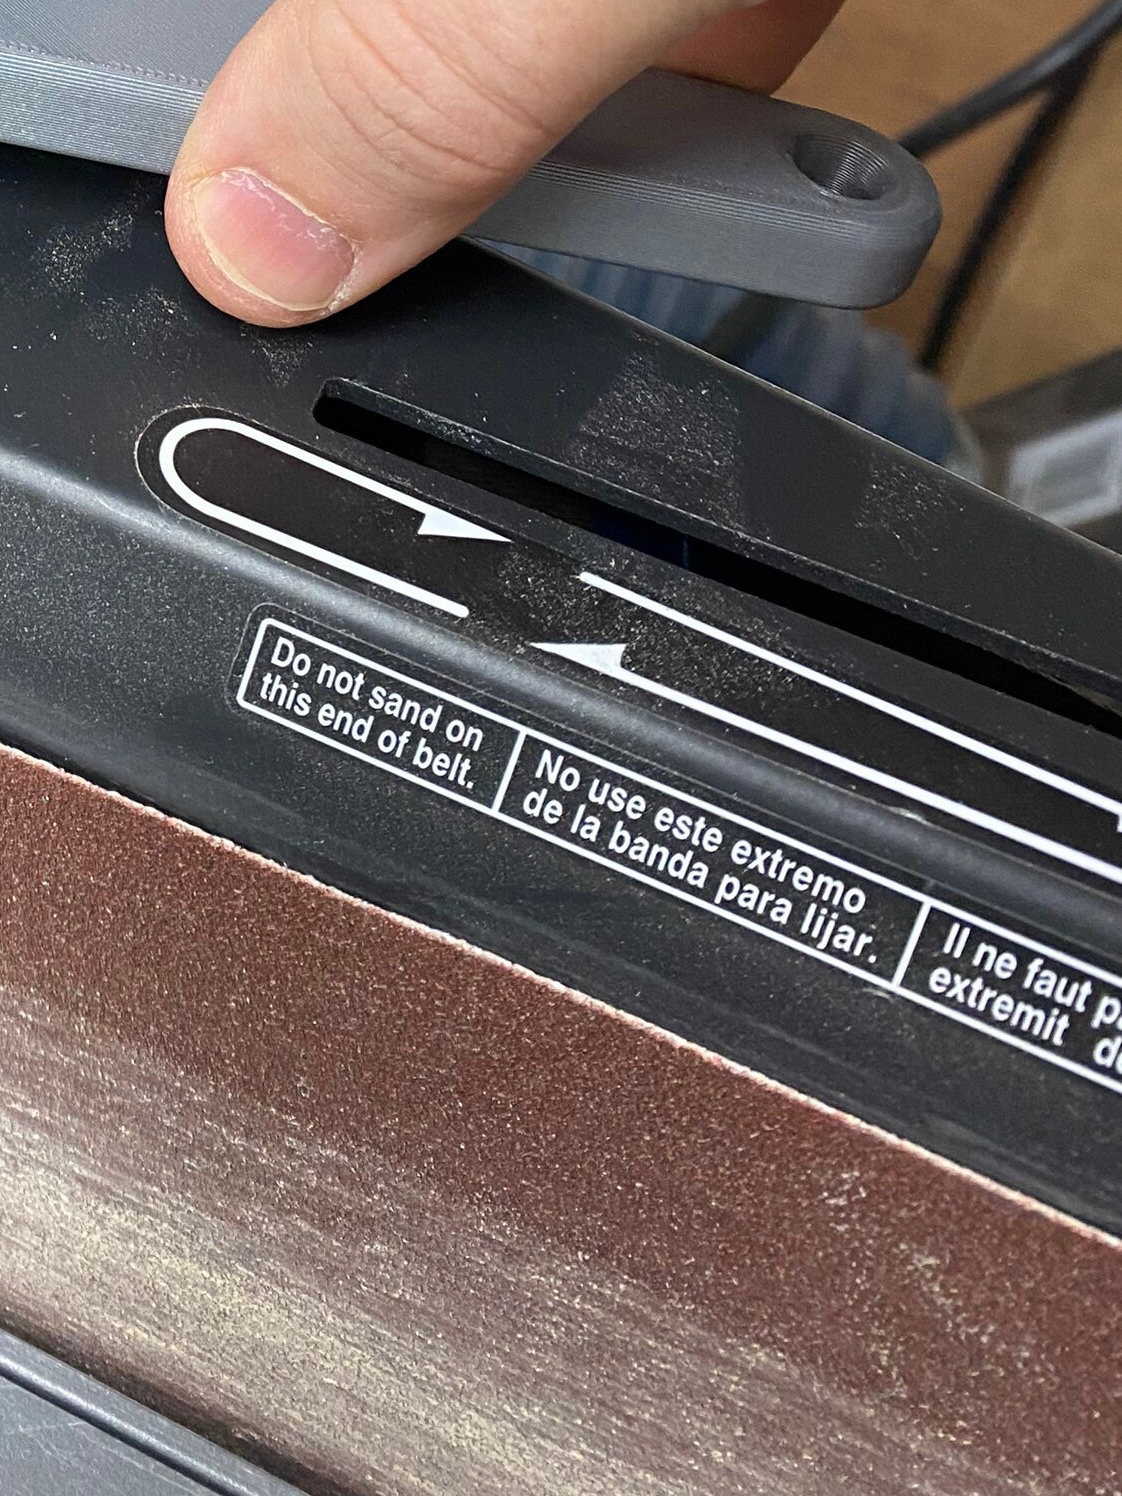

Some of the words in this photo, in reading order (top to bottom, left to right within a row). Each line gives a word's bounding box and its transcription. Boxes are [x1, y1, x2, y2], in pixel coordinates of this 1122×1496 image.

[259, 671, 312, 717] this
[317, 703, 375, 743] end
[377, 729, 412, 758] of
[412, 737, 475, 790] belt.
[270, 635, 312, 677] Do
[316, 662, 365, 701] not
[368, 685, 444, 733] sand
[445, 719, 484, 752] on
[522, 787, 563, 825] de
[570, 803, 601, 843] la
[607, 820, 709, 889] banda
[713, 873, 793, 925] para
[800, 902, 877, 964] lijar.
[534, 748, 581, 792] No
[588, 777, 647, 820] use
[653, 806, 723, 853] este
[730, 839, 866, 914] extremo
[928, 966, 1070, 1046] extremit
[942, 922, 971, 959] Il
[971, 942, 1018, 980] ne
[1022, 957, 1092, 1013] faut
